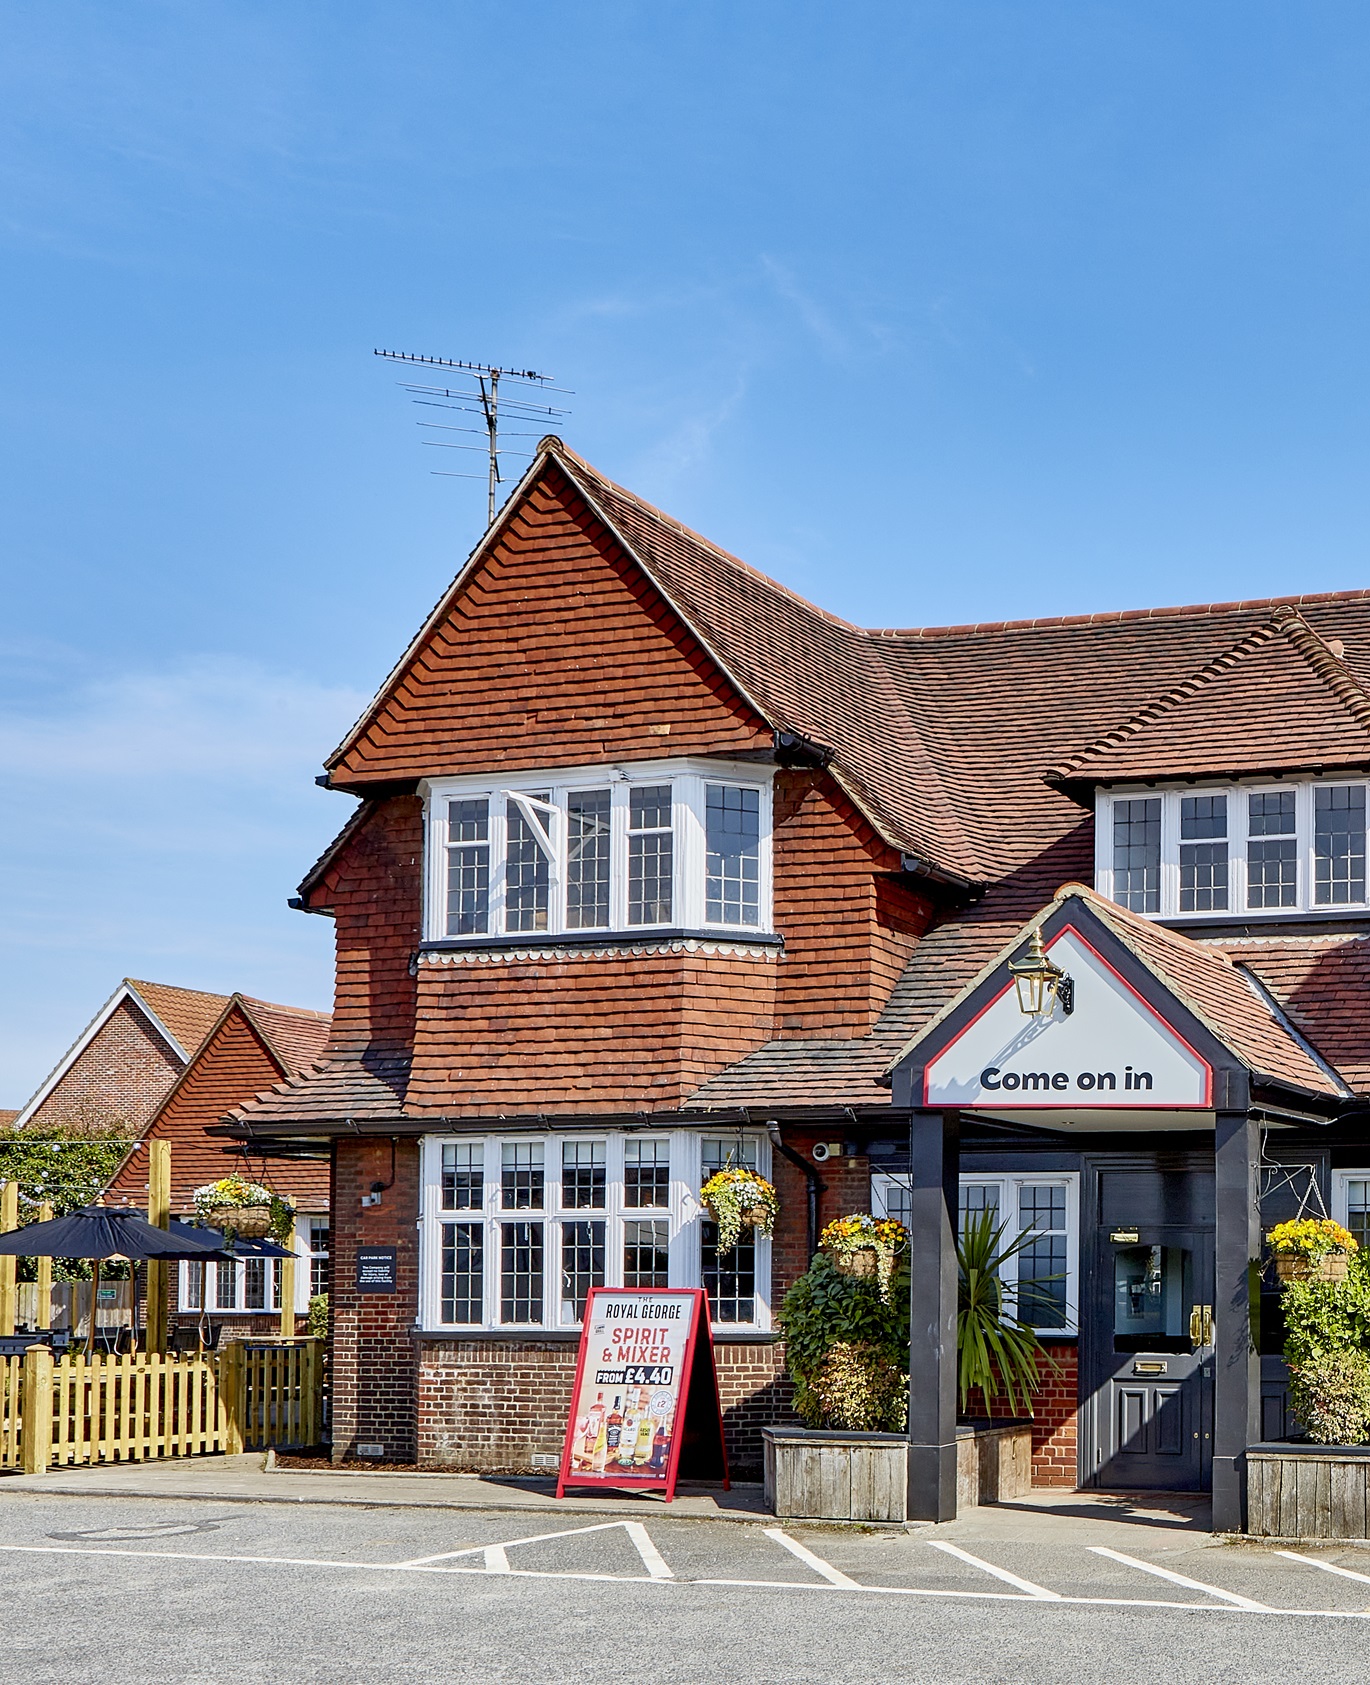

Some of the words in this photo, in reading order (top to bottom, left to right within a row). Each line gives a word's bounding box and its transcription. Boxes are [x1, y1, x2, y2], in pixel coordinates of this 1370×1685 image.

[980, 1067, 1069, 1091] Come
[1076, 1072, 1116, 1091] on
[1124, 1066, 1153, 1090] in
[606, 1304, 638, 1319] ROYAL
[641, 1304, 682, 1319] GEORGE
[612, 1327, 669, 1345] SPIRIT
[602, 1348, 612, 1362] &
[617, 1346, 671, 1363] MIXER
[596, 1372, 624, 1384] FROM
[624, 1367, 672, 1384] £4.40
